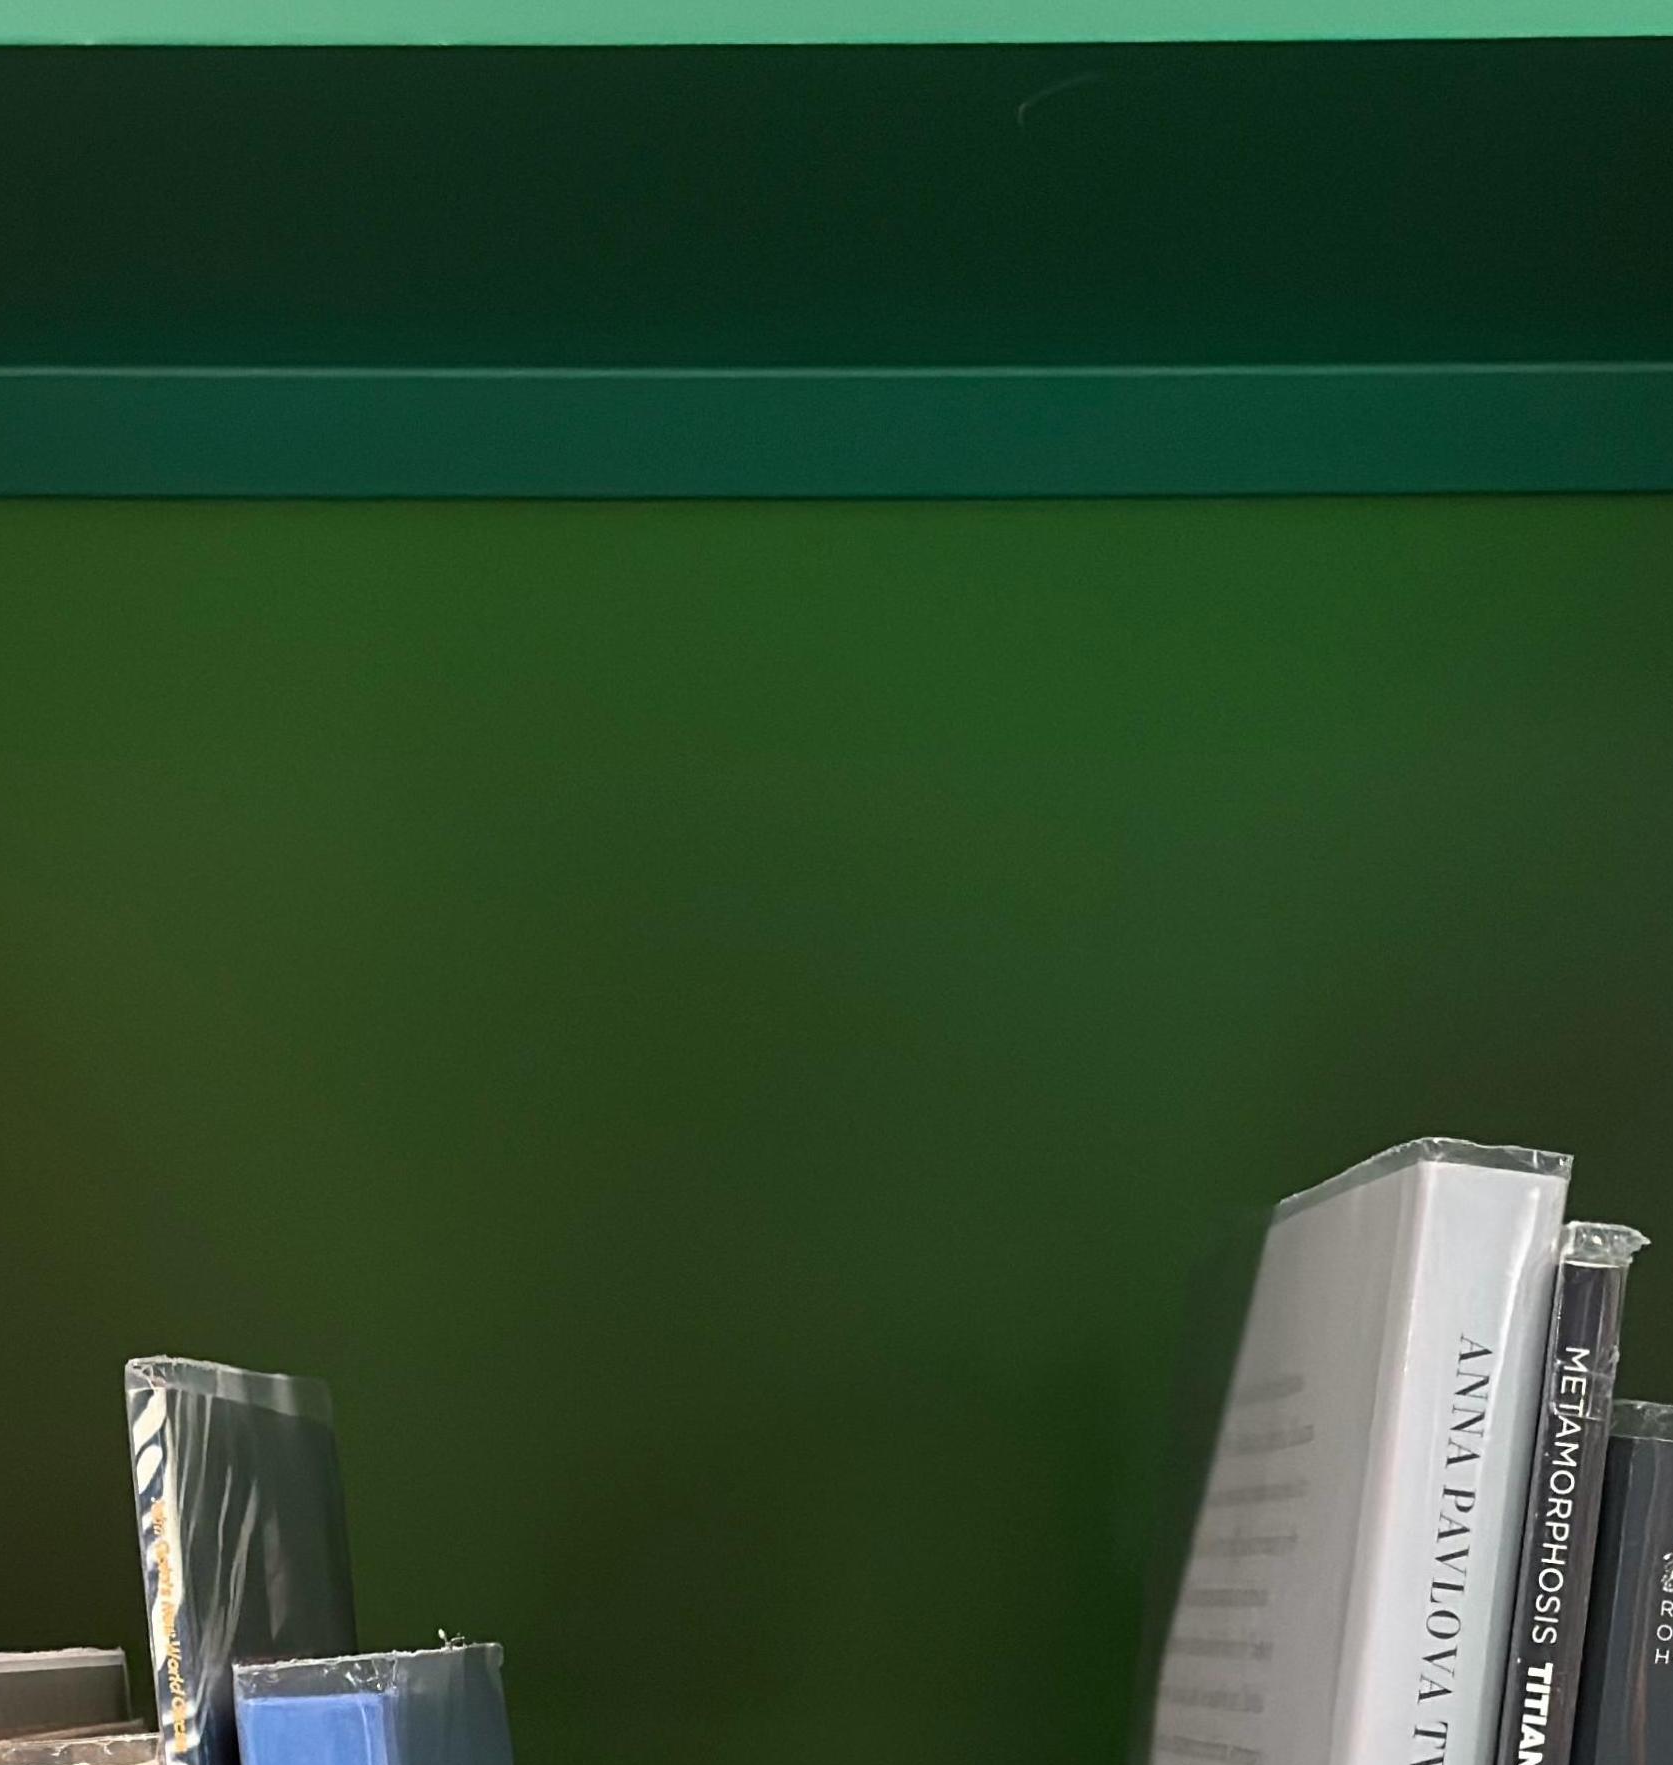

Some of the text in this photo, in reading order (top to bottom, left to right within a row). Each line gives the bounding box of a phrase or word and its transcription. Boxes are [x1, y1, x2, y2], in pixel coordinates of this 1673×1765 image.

[1444, 1332, 1493, 1468] ANNA
[1531, 1347, 1591, 1645] METAMORPHOSIS
[1416, 1485, 1477, 1704] PAVLOVA
